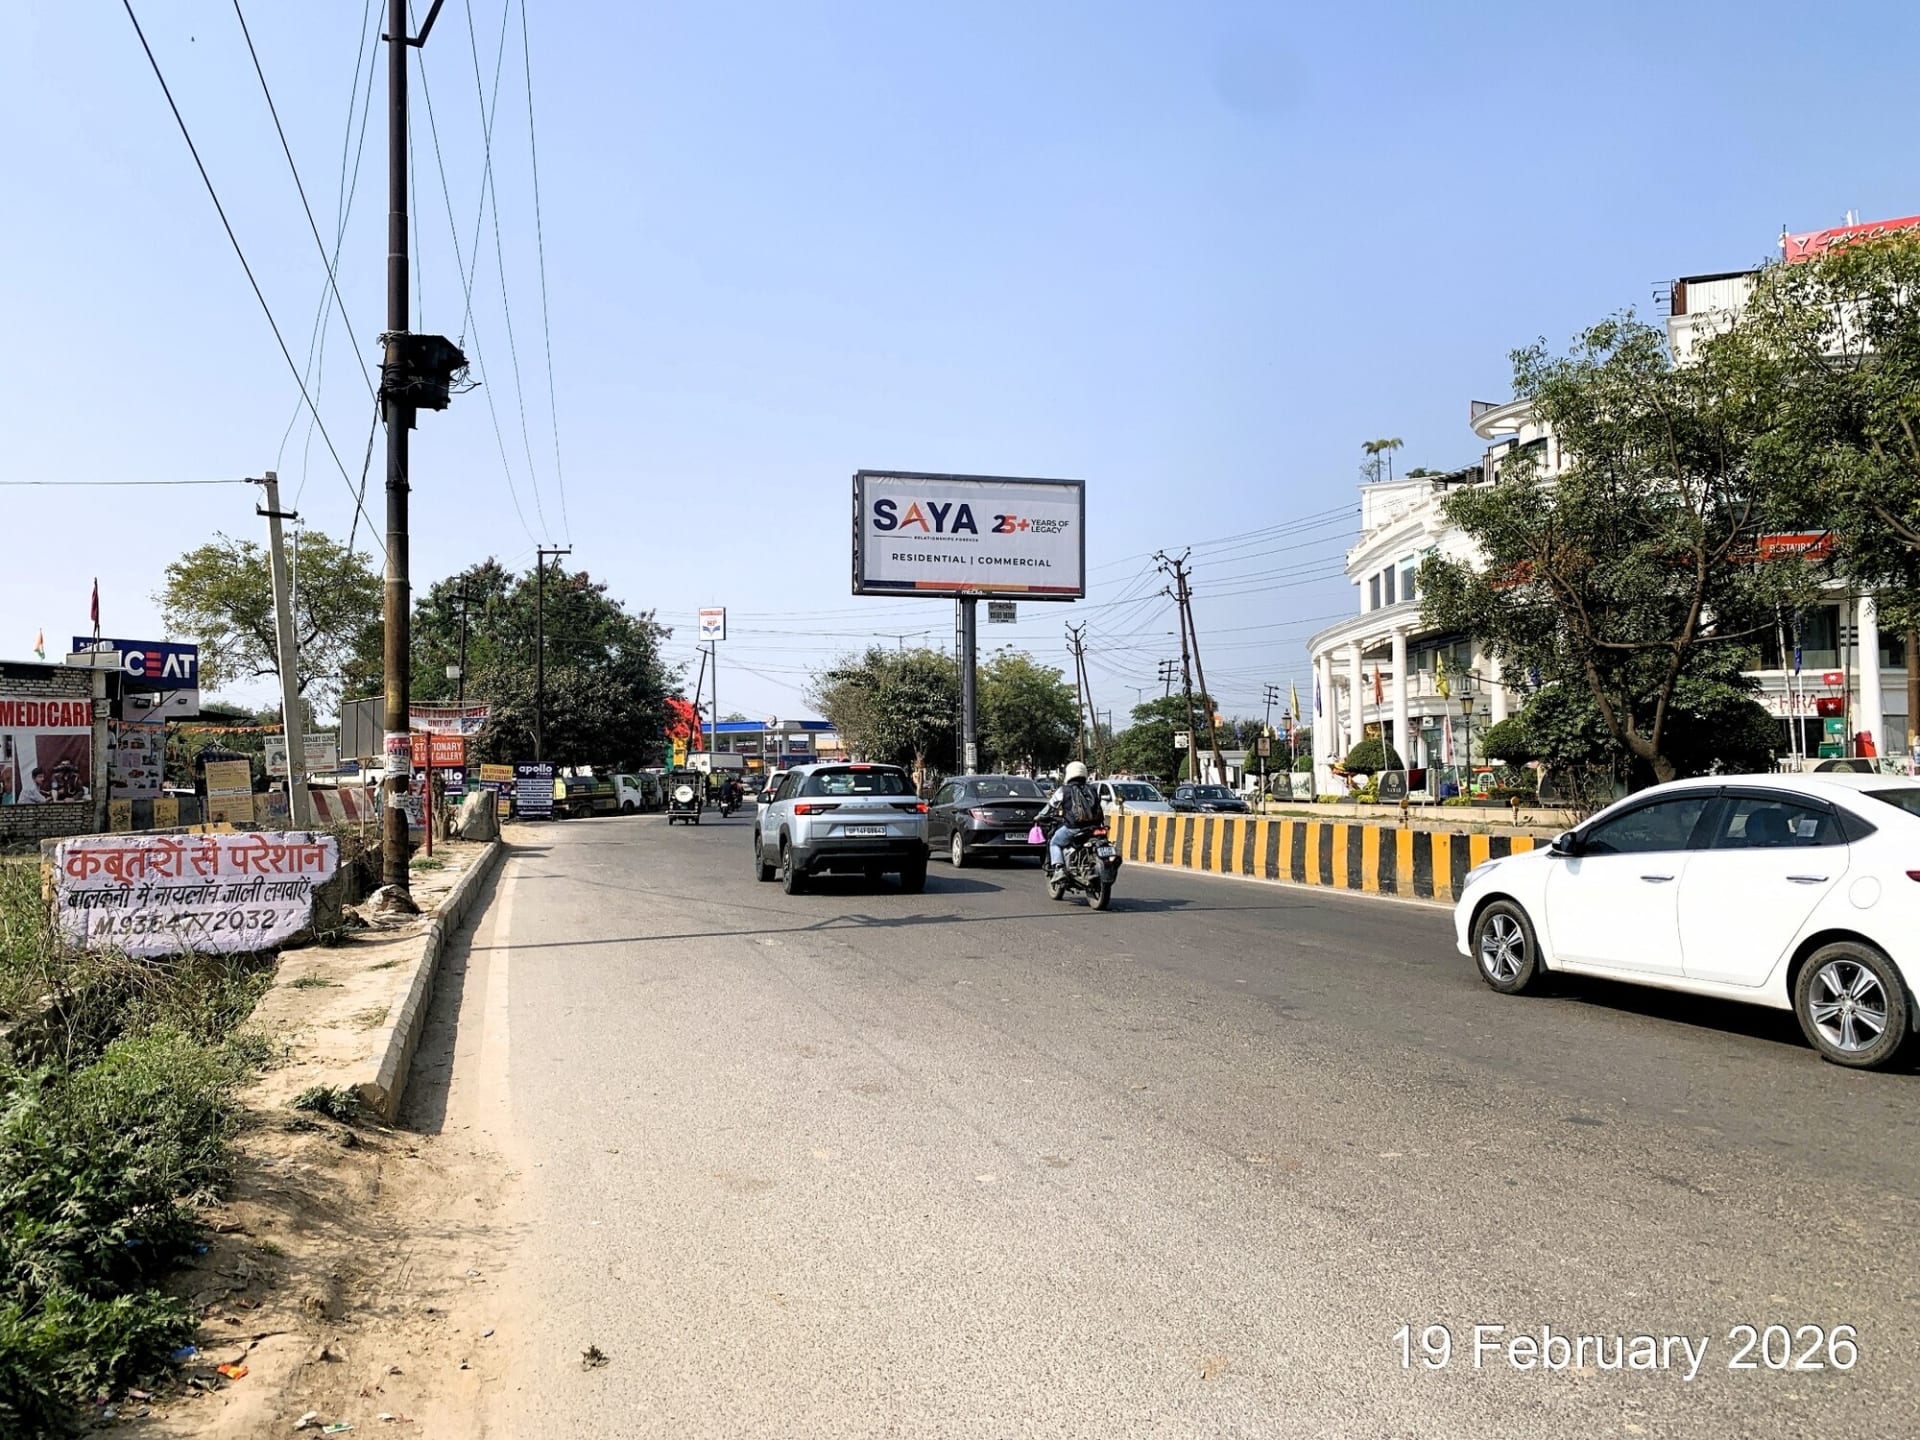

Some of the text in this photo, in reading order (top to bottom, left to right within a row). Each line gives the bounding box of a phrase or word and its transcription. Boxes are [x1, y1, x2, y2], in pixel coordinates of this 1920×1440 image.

[873, 499, 979, 535] SAYA
[1031, 519, 1057, 527] YEARS
[1031, 526, 1062, 534] LEGACY
[892, 553, 1052, 568] RESIDENTIAL COMMERCIAL
[124, 650, 195, 679] CEAT
[414, 742, 462, 752] STIONARY
[518, 763, 553, 775] apollo
[191, 837, 219, 876] से
[227, 835, 328, 875] परेशान
[136, 882, 153, 907] में
[223, 876, 265, 905] जाली
